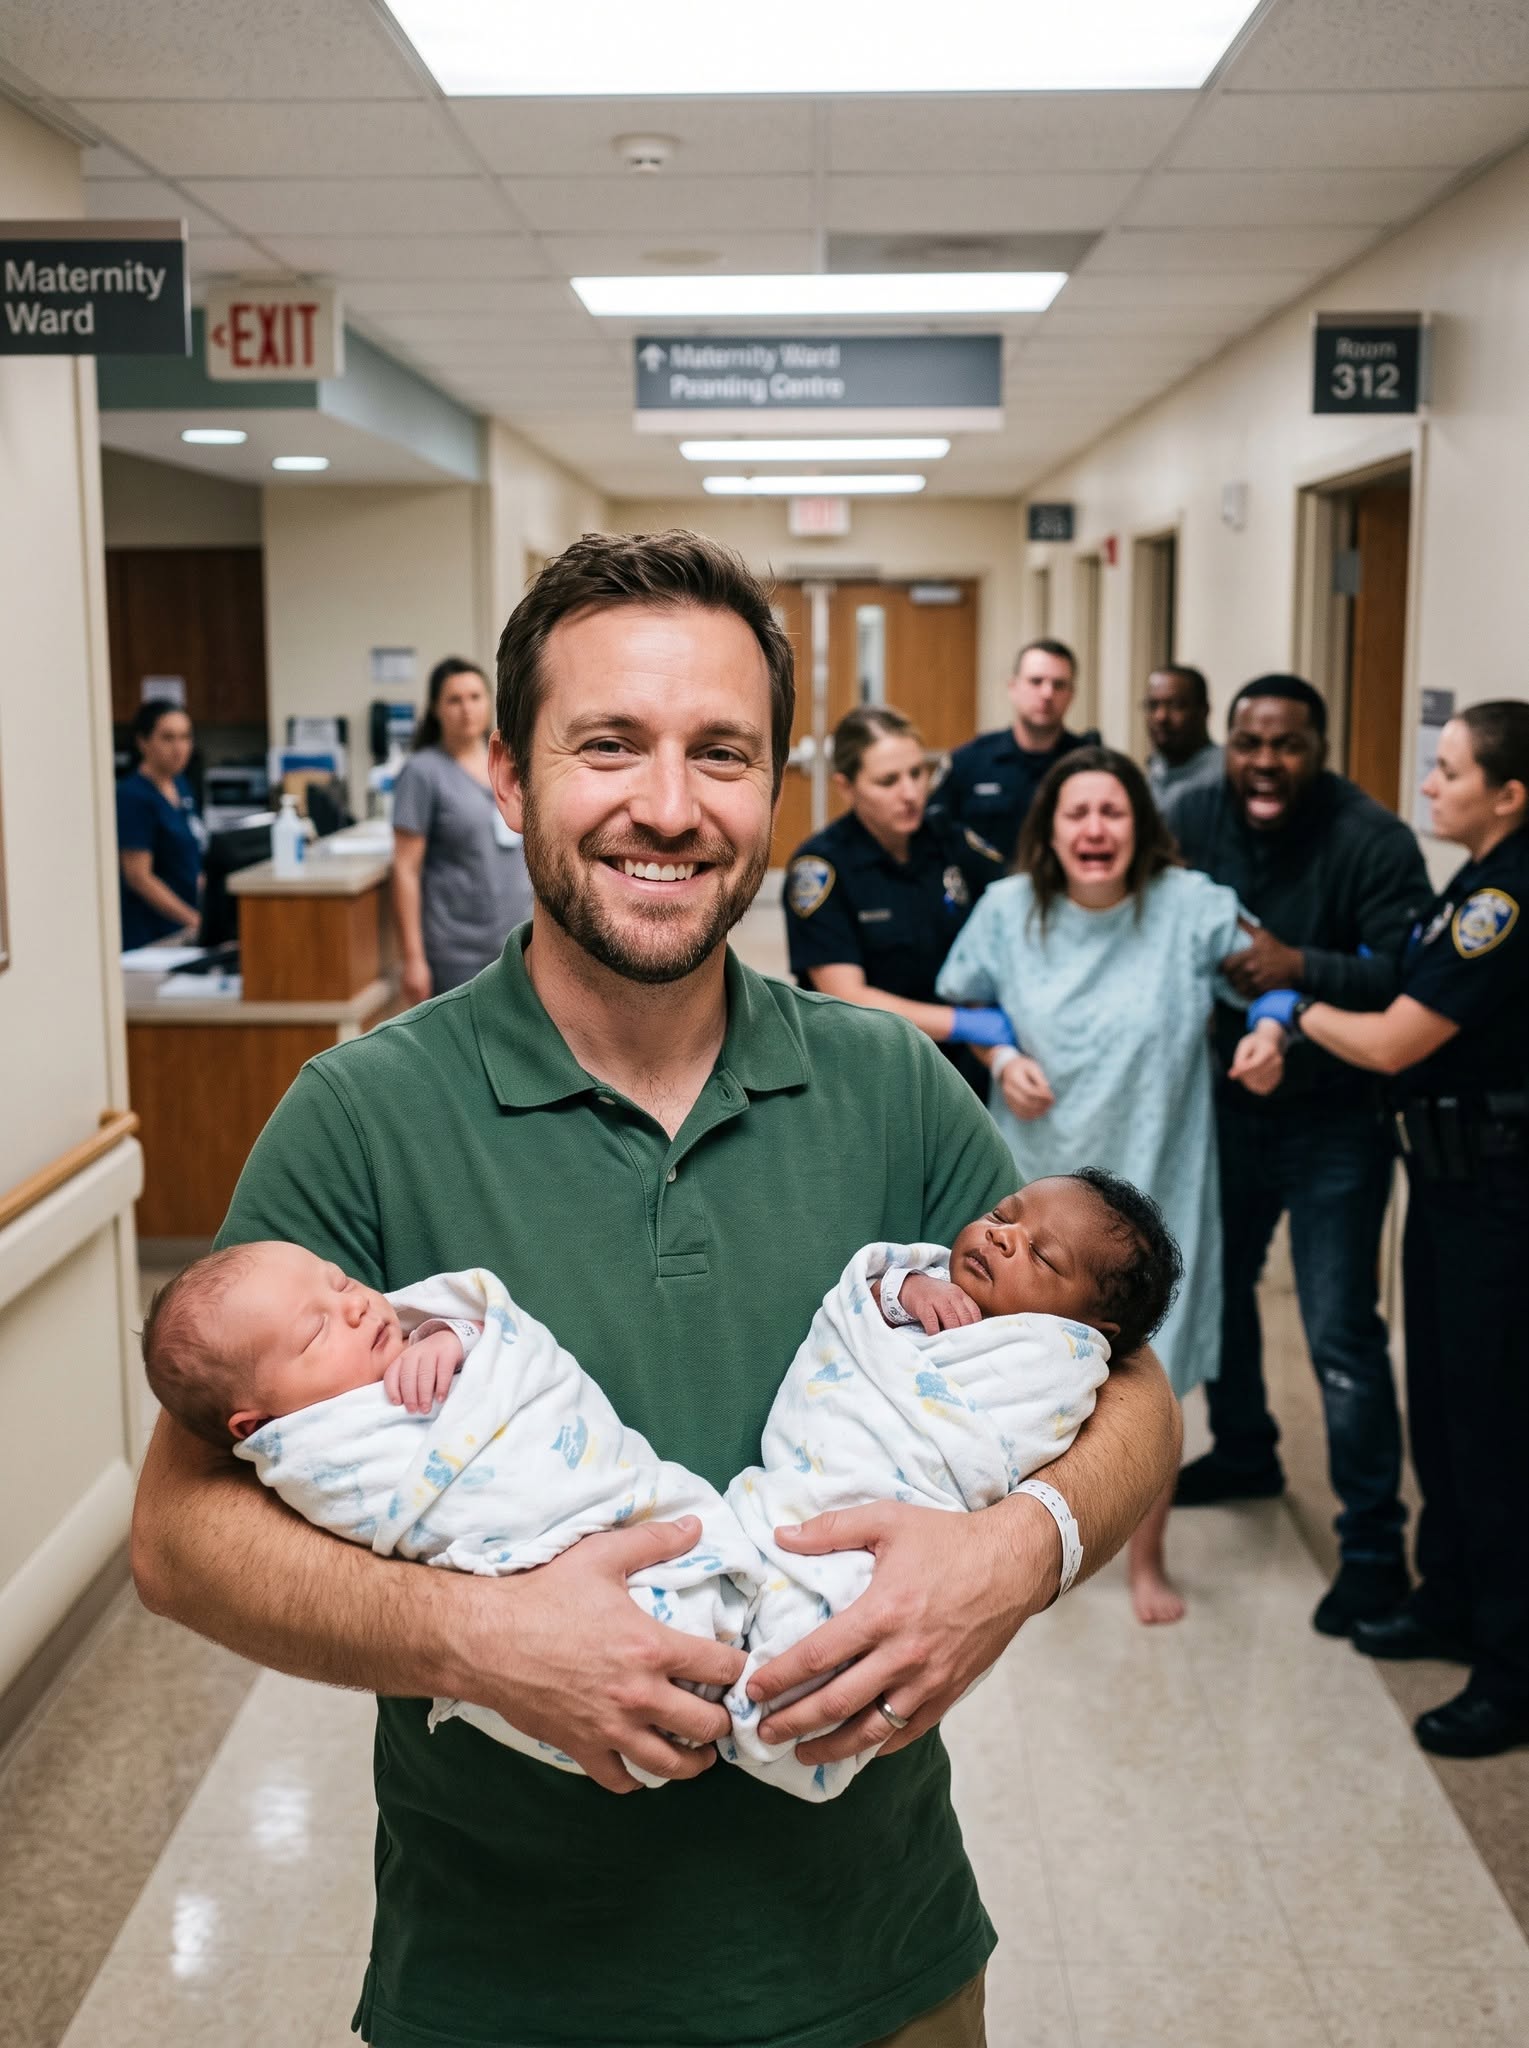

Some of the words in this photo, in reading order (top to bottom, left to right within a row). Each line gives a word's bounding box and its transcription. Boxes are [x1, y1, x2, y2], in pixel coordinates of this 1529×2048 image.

[5, 259, 166, 301] Maternity
[5, 301, 95, 335] Ward
[229, 303, 319, 368] EXIT
[779, 343, 841, 369] Ward
[1336, 336, 1398, 359] Room
[1330, 362, 1401, 400] 312
